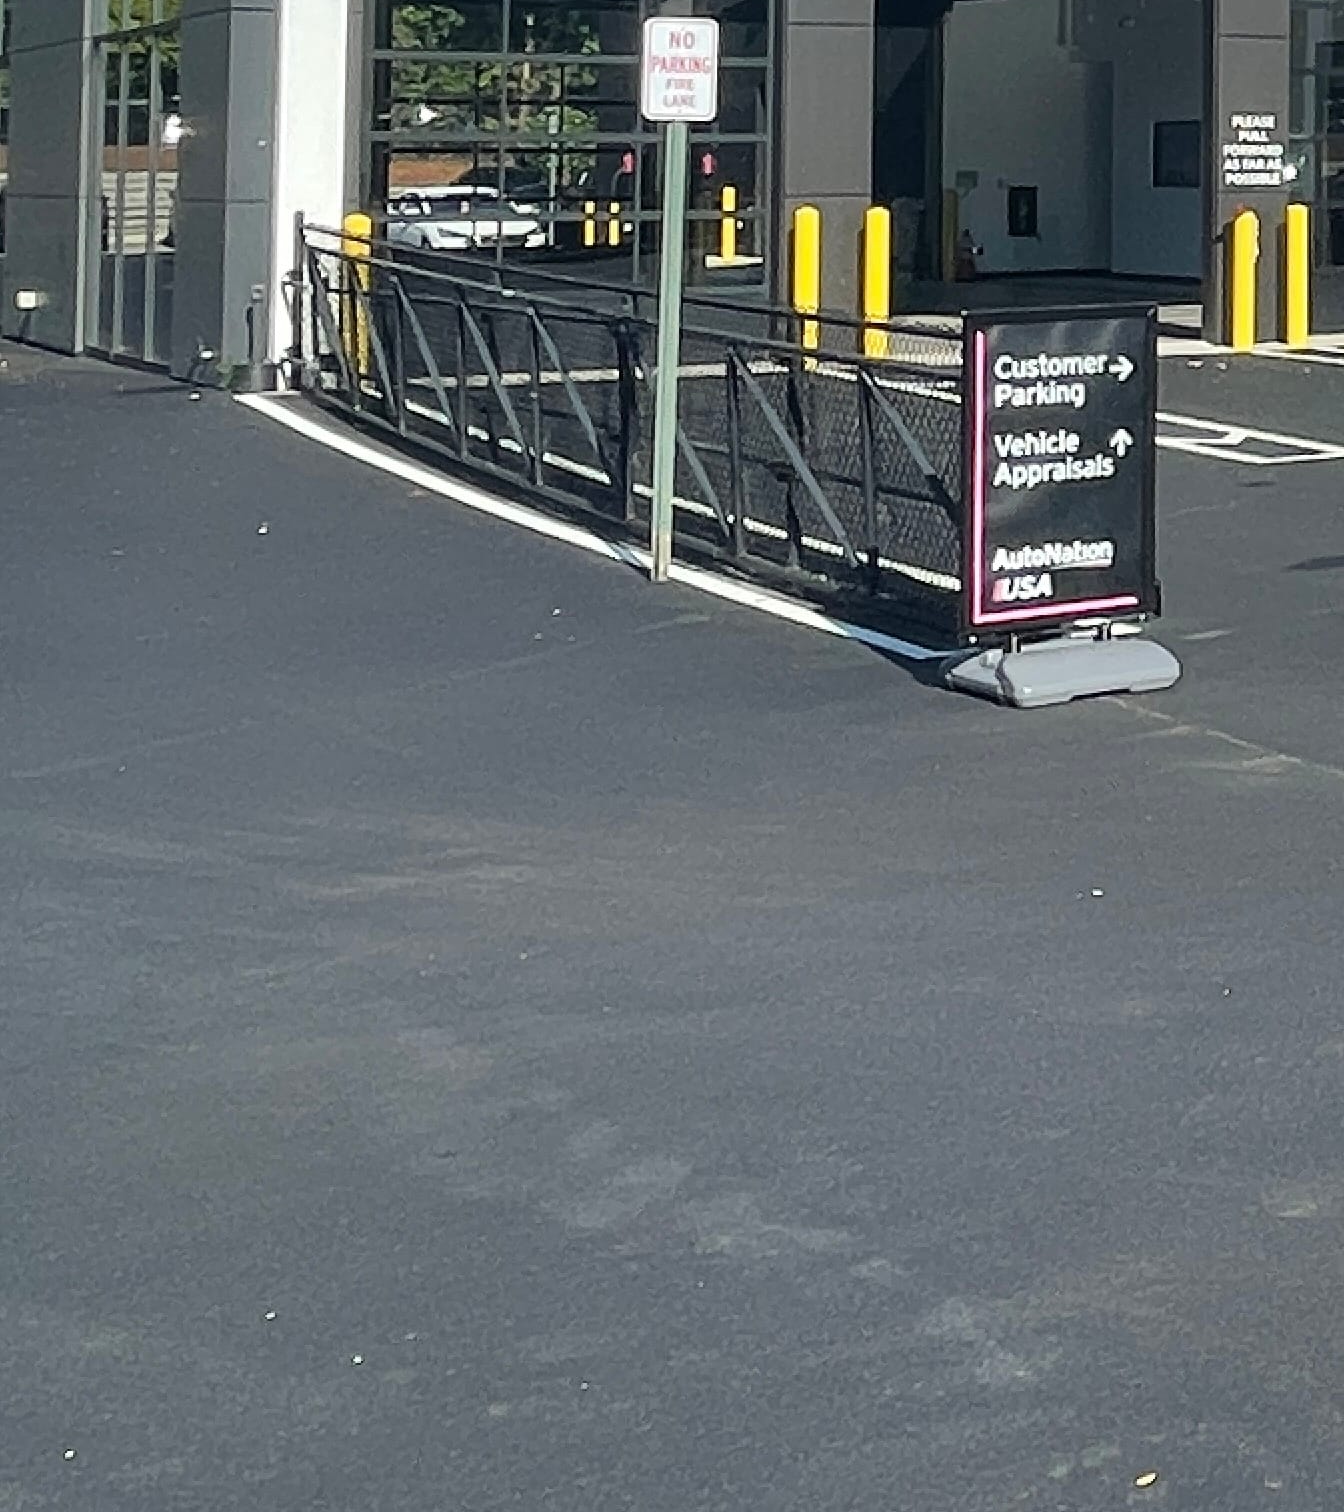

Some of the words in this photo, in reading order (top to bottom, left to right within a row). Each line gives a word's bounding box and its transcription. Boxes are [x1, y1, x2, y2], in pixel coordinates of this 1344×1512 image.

[668, 30, 696, 50] NO
[648, 56, 712, 74] PARKING
[1231, 114, 1276, 129] PLEASE
[993, 353, 1108, 380] Customer
[994, 381, 1086, 408] Parking
[994, 429, 1080, 458] Vehicle
[992, 453, 1115, 490] Appraisals
[992, 540, 1114, 571] AutoNation
[1003, 573, 1053, 601] USA
